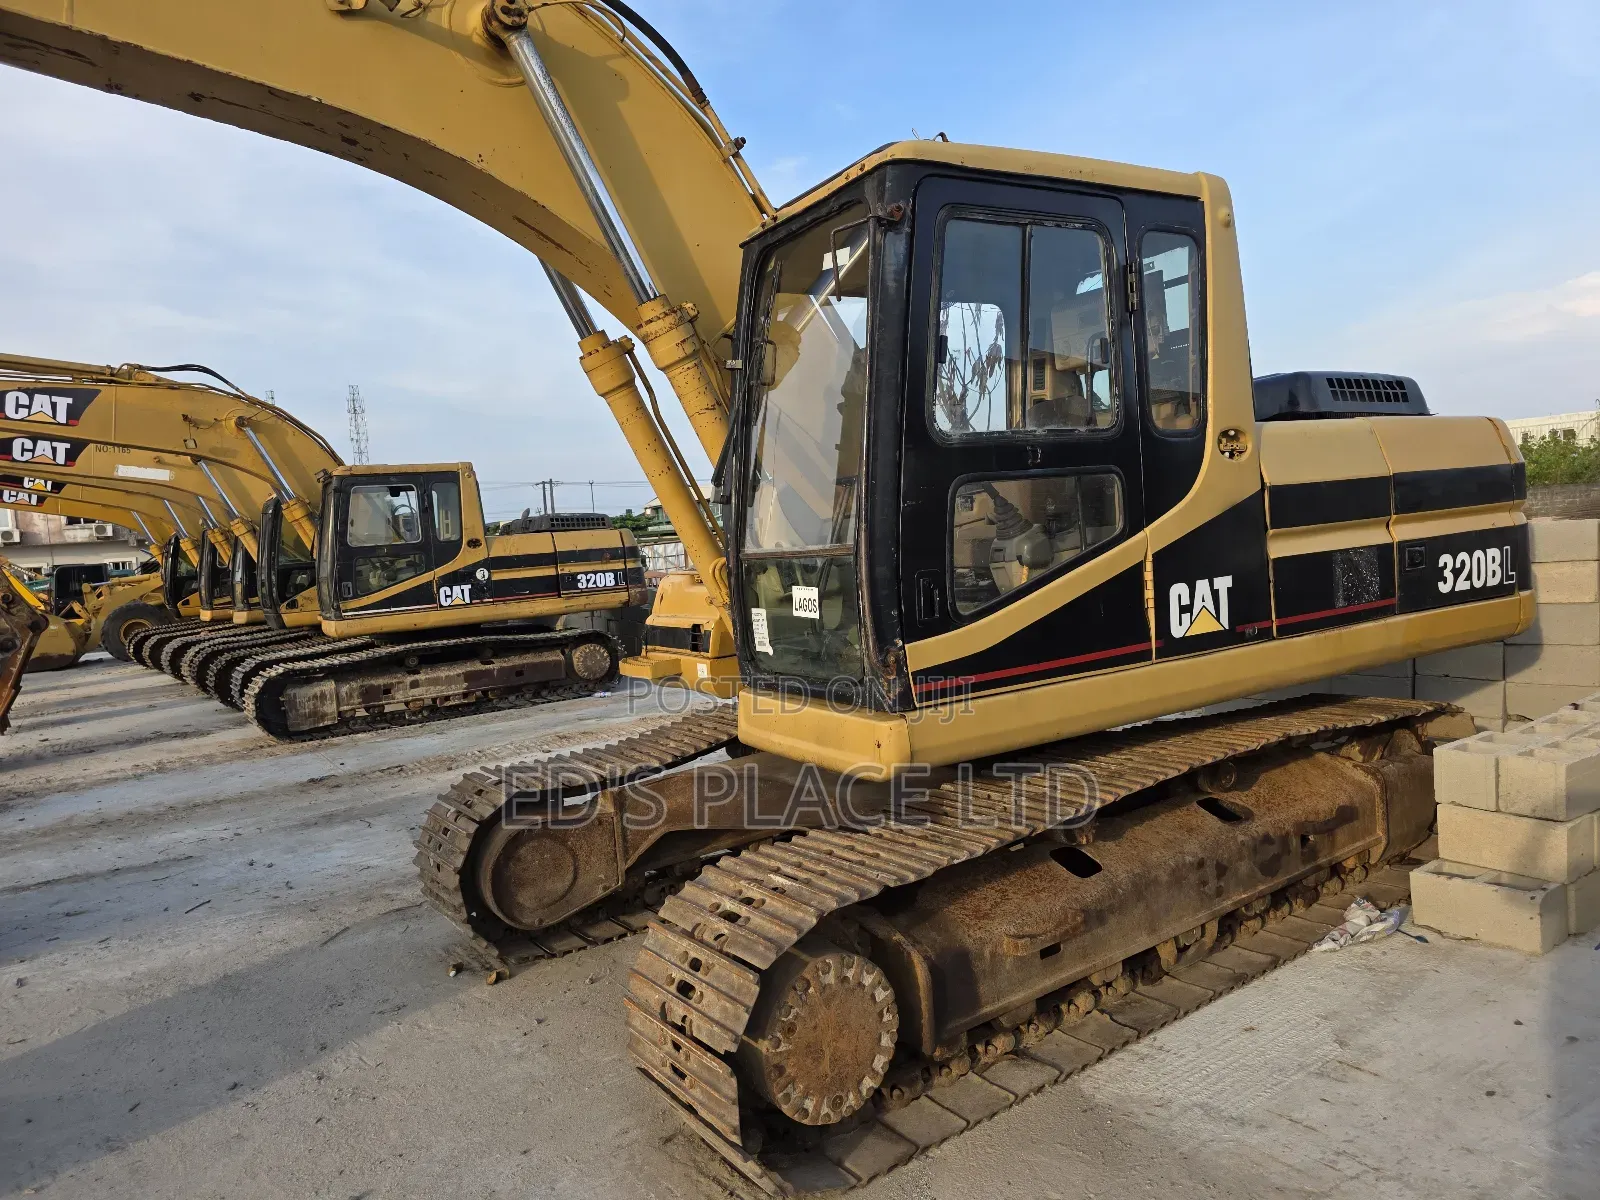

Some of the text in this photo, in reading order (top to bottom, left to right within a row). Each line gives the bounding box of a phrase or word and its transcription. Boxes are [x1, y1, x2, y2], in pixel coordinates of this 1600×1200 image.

[4, 390, 73, 425] CAT
[12, 437, 71, 465] CAT
[439, 584, 472, 607] CAT
[794, 597, 818, 613] LAGOS
[1169, 574, 1233, 639] CAT
